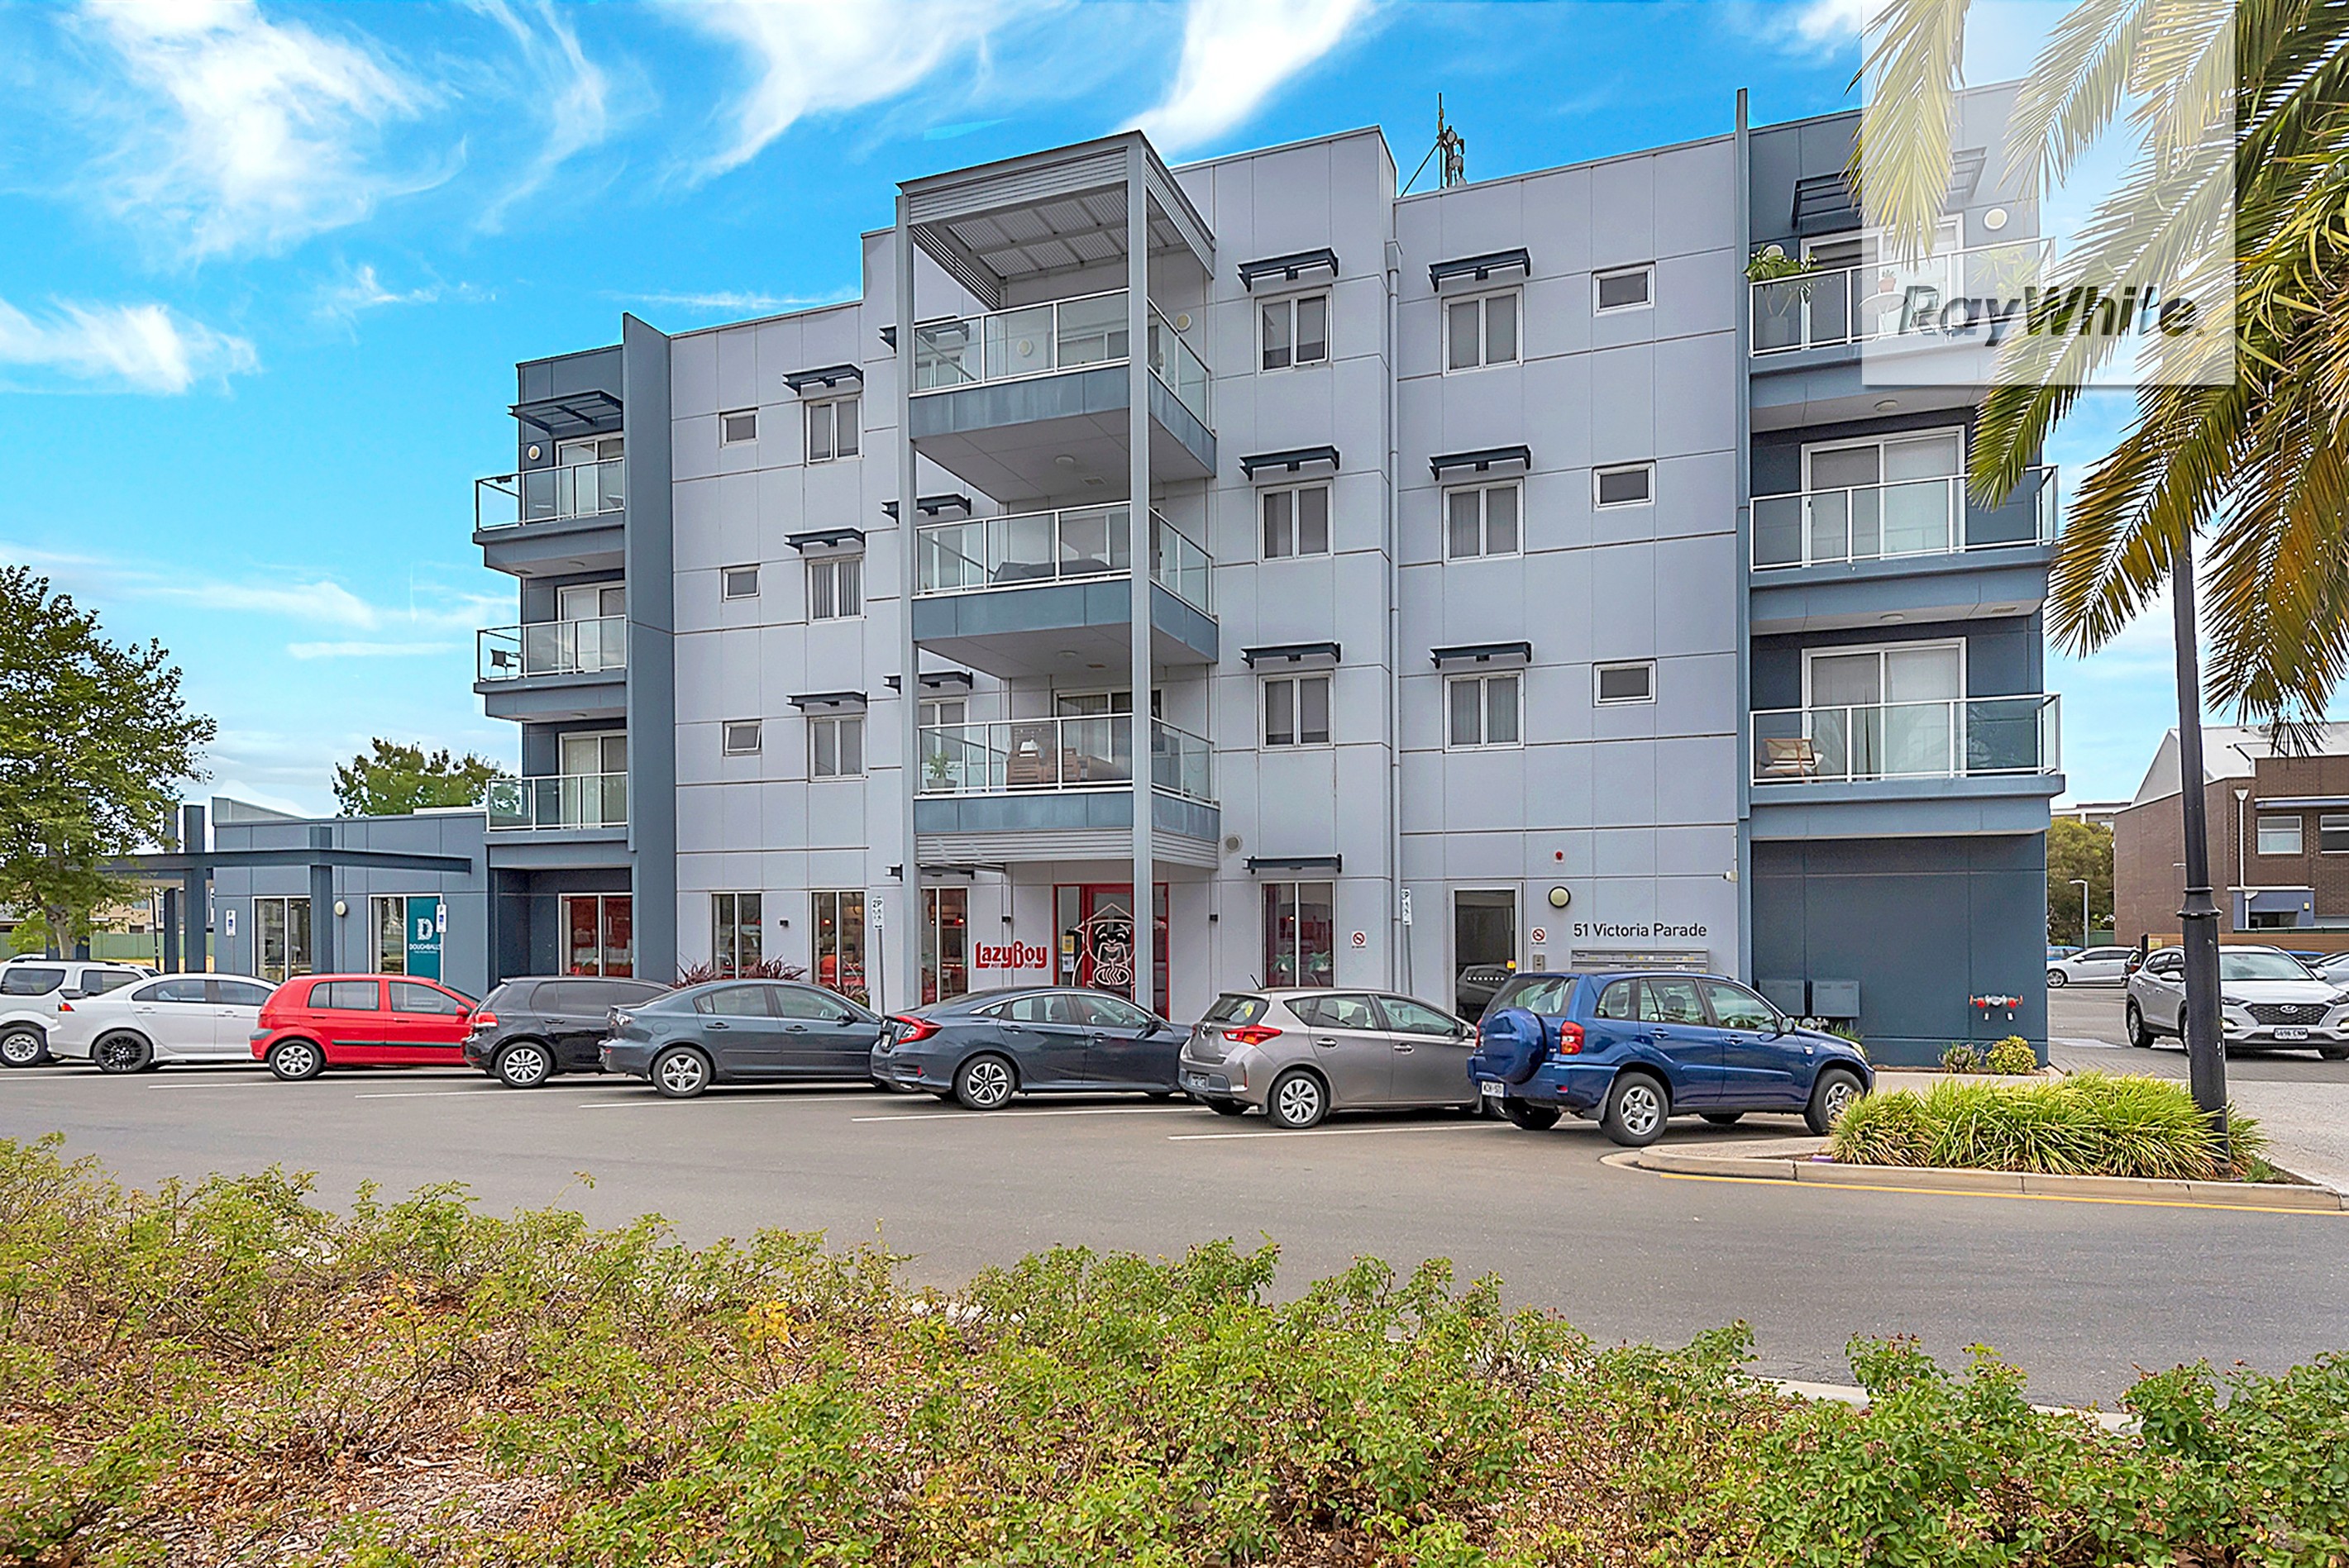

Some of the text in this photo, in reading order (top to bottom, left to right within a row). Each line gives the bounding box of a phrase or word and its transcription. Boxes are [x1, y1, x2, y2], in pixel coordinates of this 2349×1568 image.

[1573, 923, 1707, 937] 51 Victoria Parade
[975, 940, 1048, 969] LazyBoy
